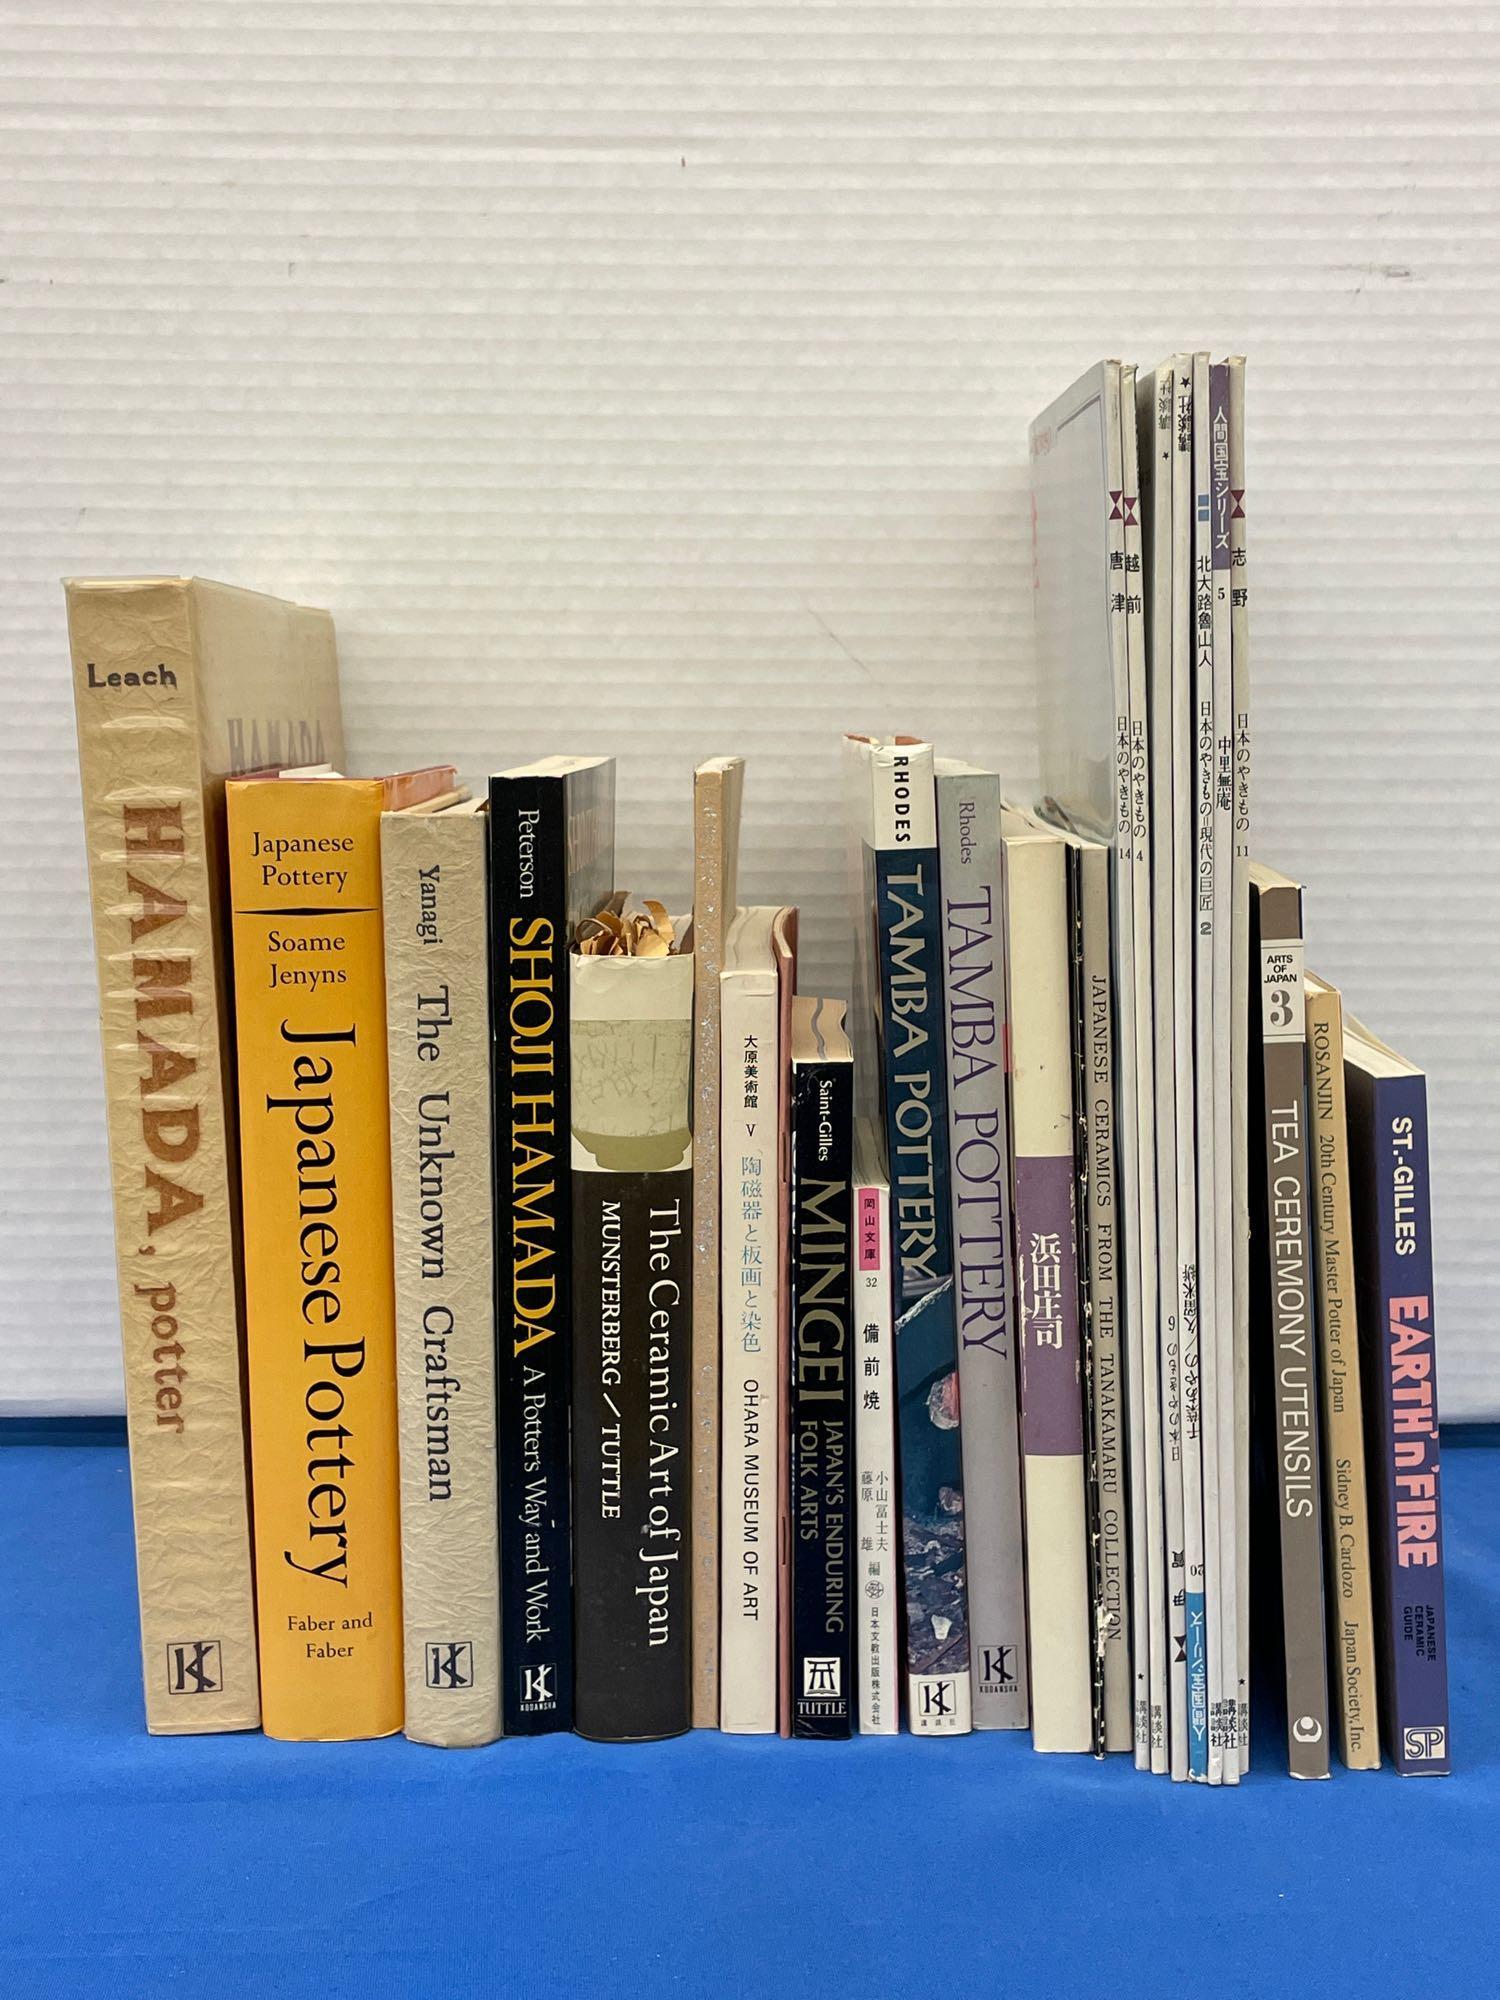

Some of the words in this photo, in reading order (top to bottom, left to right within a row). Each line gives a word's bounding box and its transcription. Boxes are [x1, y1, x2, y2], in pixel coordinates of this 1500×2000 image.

[1213, 405, 1230, 551] 人間国宝シリーズ
[1217, 587, 1226, 600] 5
[87, 662, 178, 690] Leach
[892, 755, 911, 843] RHODES
[1116, 715, 1131, 835] 日本のやきもの
[1131, 720, 1147, 839] 日本のやきもの
[1235, 713, 1251, 832] 日本のやきもの
[252, 831, 355, 862] Japanese
[517, 808, 541, 899] Peterson
[958, 801, 977, 865] Rhodes
[1118, 847, 1131, 860] 14
[1135, 849, 1144, 863] 4
[1236, 845, 1250, 857] 11
[261, 864, 348, 894] Pottery
[415, 864, 443, 947] Yanagi
[268, 930, 346, 954] Soame
[1199, 921, 1212, 936] 2
[1266, 954, 1294, 966] ARTS
[269, 962, 348, 992] Jenyns
[883, 863, 933, 1058] TAMBA
[946, 885, 998, 1091] TAMBA
[1263, 974, 1298, 985] JAPAN
[1272, 964, 1288, 975] OF
[417, 984, 453, 1063] The
[509, 916, 555, 1077] SHOJI
[1269, 989, 1294, 1028] 3
[1091, 973, 1110, 1085] JAPANESE
[743, 1034, 759, 1109] 大原美術館
[1313, 1021, 1335, 1122] ROSANJIN
[745, 1123, 757, 1138] V
[818, 1079, 834, 1162] Saint-Gilles
[1271, 1099, 1300, 1165] TEA
[266, 1018, 357, 1325] Japanese
[417, 1090, 453, 1280] Unknown
[893, 1069, 937, 1280] POTTERY
[1094, 1099, 1112, 1209] CERAMICS
[1319, 1134, 1336, 1173] 20th
[1318, 1174, 1337, 1236] Century
[1391, 1116, 1416, 1258] ST.-GILLES
[511, 1090, 558, 1358] HAMADA
[649, 1198, 682, 1268] The
[740, 1155, 763, 1353] 陶磁器と板画と染色
[863, 1198, 877, 1261] 岡山文庫
[954, 1107, 1008, 1361] POTTERY
[1096, 1222, 1113, 1283] FROM
[601, 1200, 622, 1386] MUNSTERBERG
[799, 1178, 847, 1403] MINGEI
[865, 1277, 878, 1292] 32
[1030, 1232, 1063, 1351] 浜田庄司
[1273, 1175, 1309, 1357] CEREMONY
[1324, 1239, 1340, 1294] Master
[1099, 1296, 1115, 1340] THE
[1326, 1298, 1342, 1343] Potter
[134, 1281, 190, 1436] potter
[523, 1365, 547, 1388] A
[649, 1280, 682, 1435] Ceramic
[863, 1322, 881, 1411] 備前焼
[1330, 1346, 1345, 1365] of
[422, 1305, 462, 1503] Craftsman
[743, 1379, 760, 1451] OHARA
[1329, 1371, 1345, 1414] Japan
[523, 1392, 547, 1473] Potter's
[799, 1420, 818, 1480] FOLK
[1100, 1352, 1118, 1497] TANAKAMARU
[1280, 1368, 1314, 1519] UTENSILS
[283, 1335, 366, 1588] Pottery
[601, 1423, 623, 1520] TUTTLE
[649, 1442, 681, 1499] Art
[823, 1420, 845, 1502] JAPAN'S
[1336, 1459, 1354, 1513] Sidney
[518, 1477, 548, 1528] Way
[649, 1504, 681, 1541] of
[743, 1454, 760, 1545] MUSEUM
[800, 1484, 819, 1540] ARTS
[1339, 1514, 1355, 1531] B.
[525, 1533, 550, 1575] and
[743, 1551, 760, 1578] OF
[824, 1501, 845, 1635] ENDURING
[1103, 1510, 1123, 1643] COLLECTION
[1340, 1533, 1356, 1599] Cardozo
[287, 1615, 336, 1633] Faber
[341, 1613, 374, 1631] and
[526, 1579, 551, 1644] Work
[637, 1545, 681, 1647] Japan
[743, 1583, 760, 1620] ART
[1403, 1605, 1413, 1642] GUIDE
[306, 1642, 354, 1660] Faber
[1341, 1620, 1359, 1664] Japan
[1414, 1605, 1426, 1657] CERAMIC
[1425, 1604, 1437, 1662] JAPANESE
[519, 1701, 558, 1712] KODANSHA
[979, 1685, 1019, 1695] KODANSHA
[1190, 1610, 1206, 1742] 人間国宝シリーズ
[1344, 1667, 1362, 1725] Society,
[797, 1702, 849, 1715] TUTTLE
[1347, 1725, 1365, 1754] Inc.
[1405, 1728, 1444, 1758] SP
